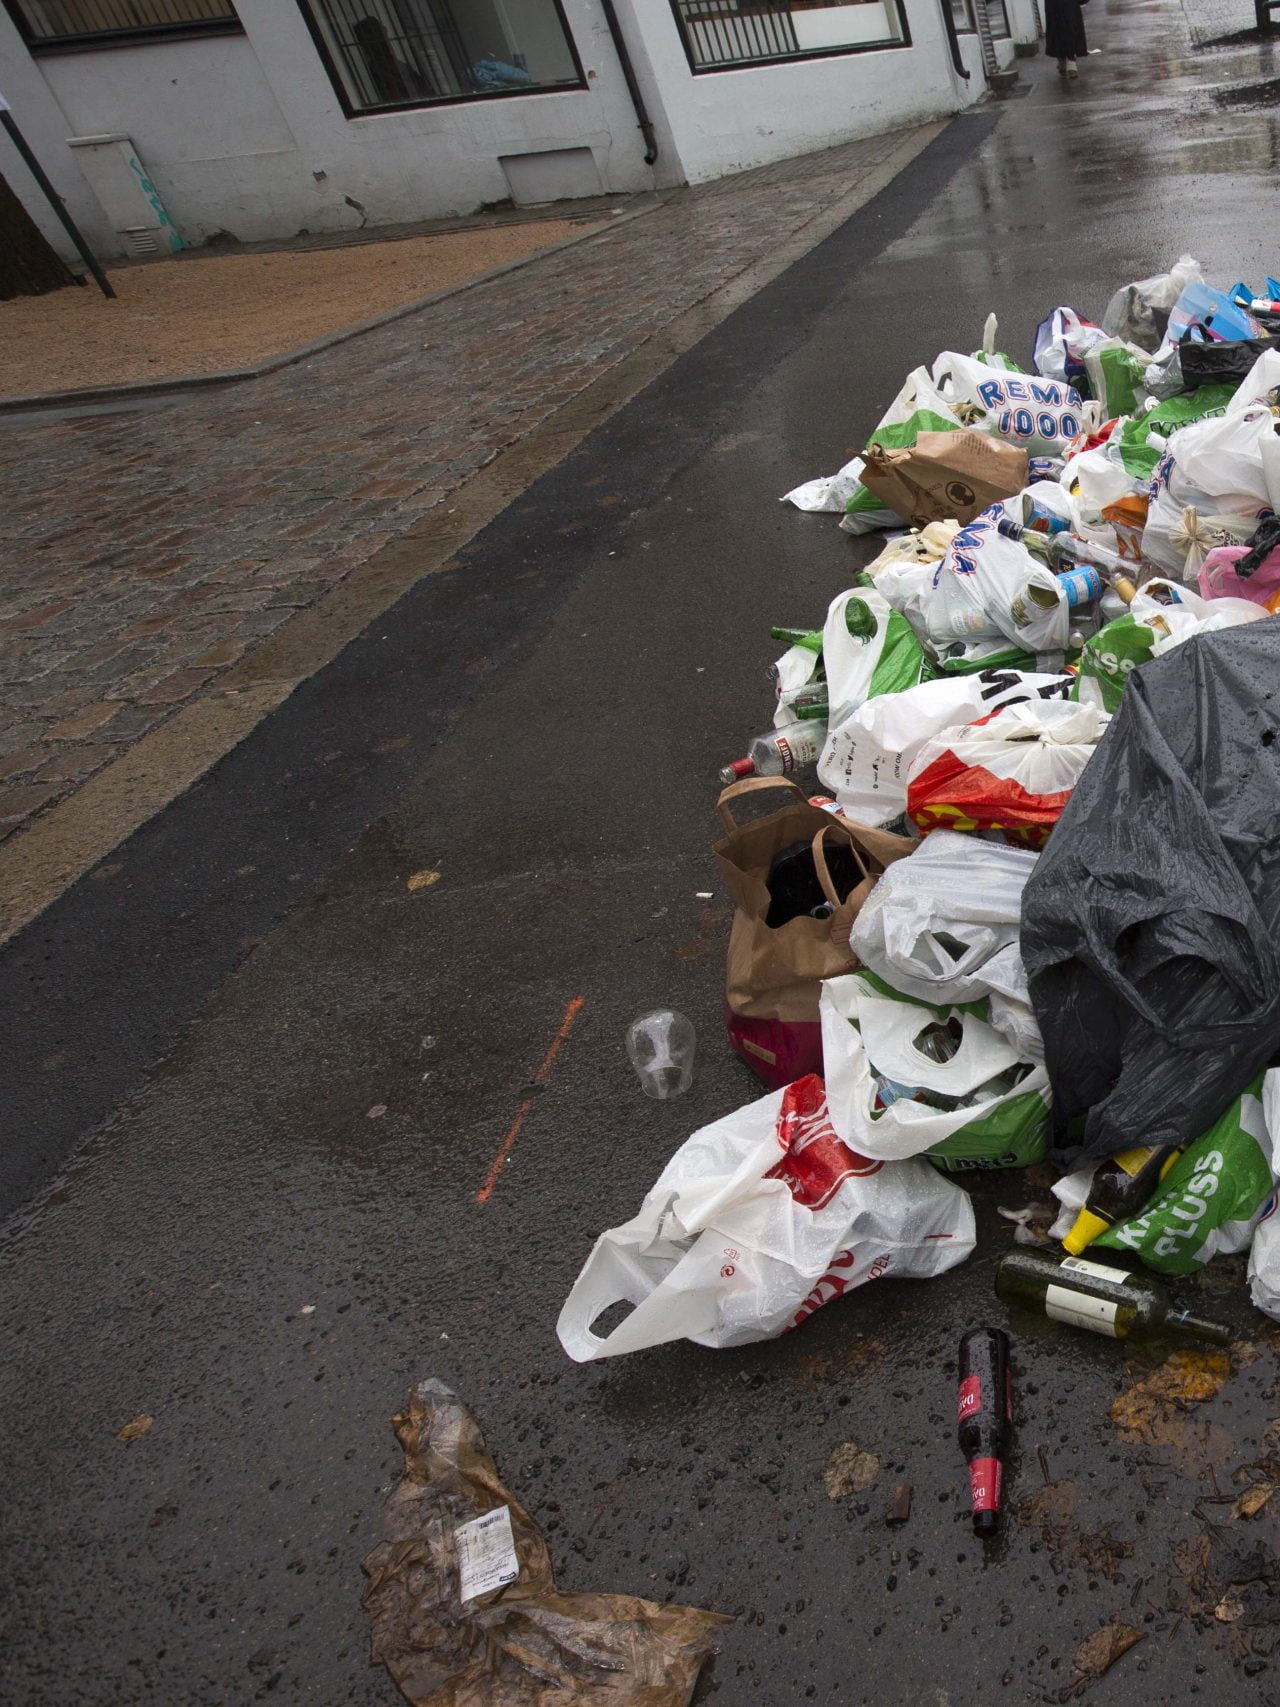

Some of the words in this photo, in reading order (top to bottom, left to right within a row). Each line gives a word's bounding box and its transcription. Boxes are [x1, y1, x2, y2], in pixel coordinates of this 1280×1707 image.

[977, 379, 1082, 409] REMA
[998, 407, 1081, 440] 1000
[1153, 1150, 1224, 1257] PLUSS
